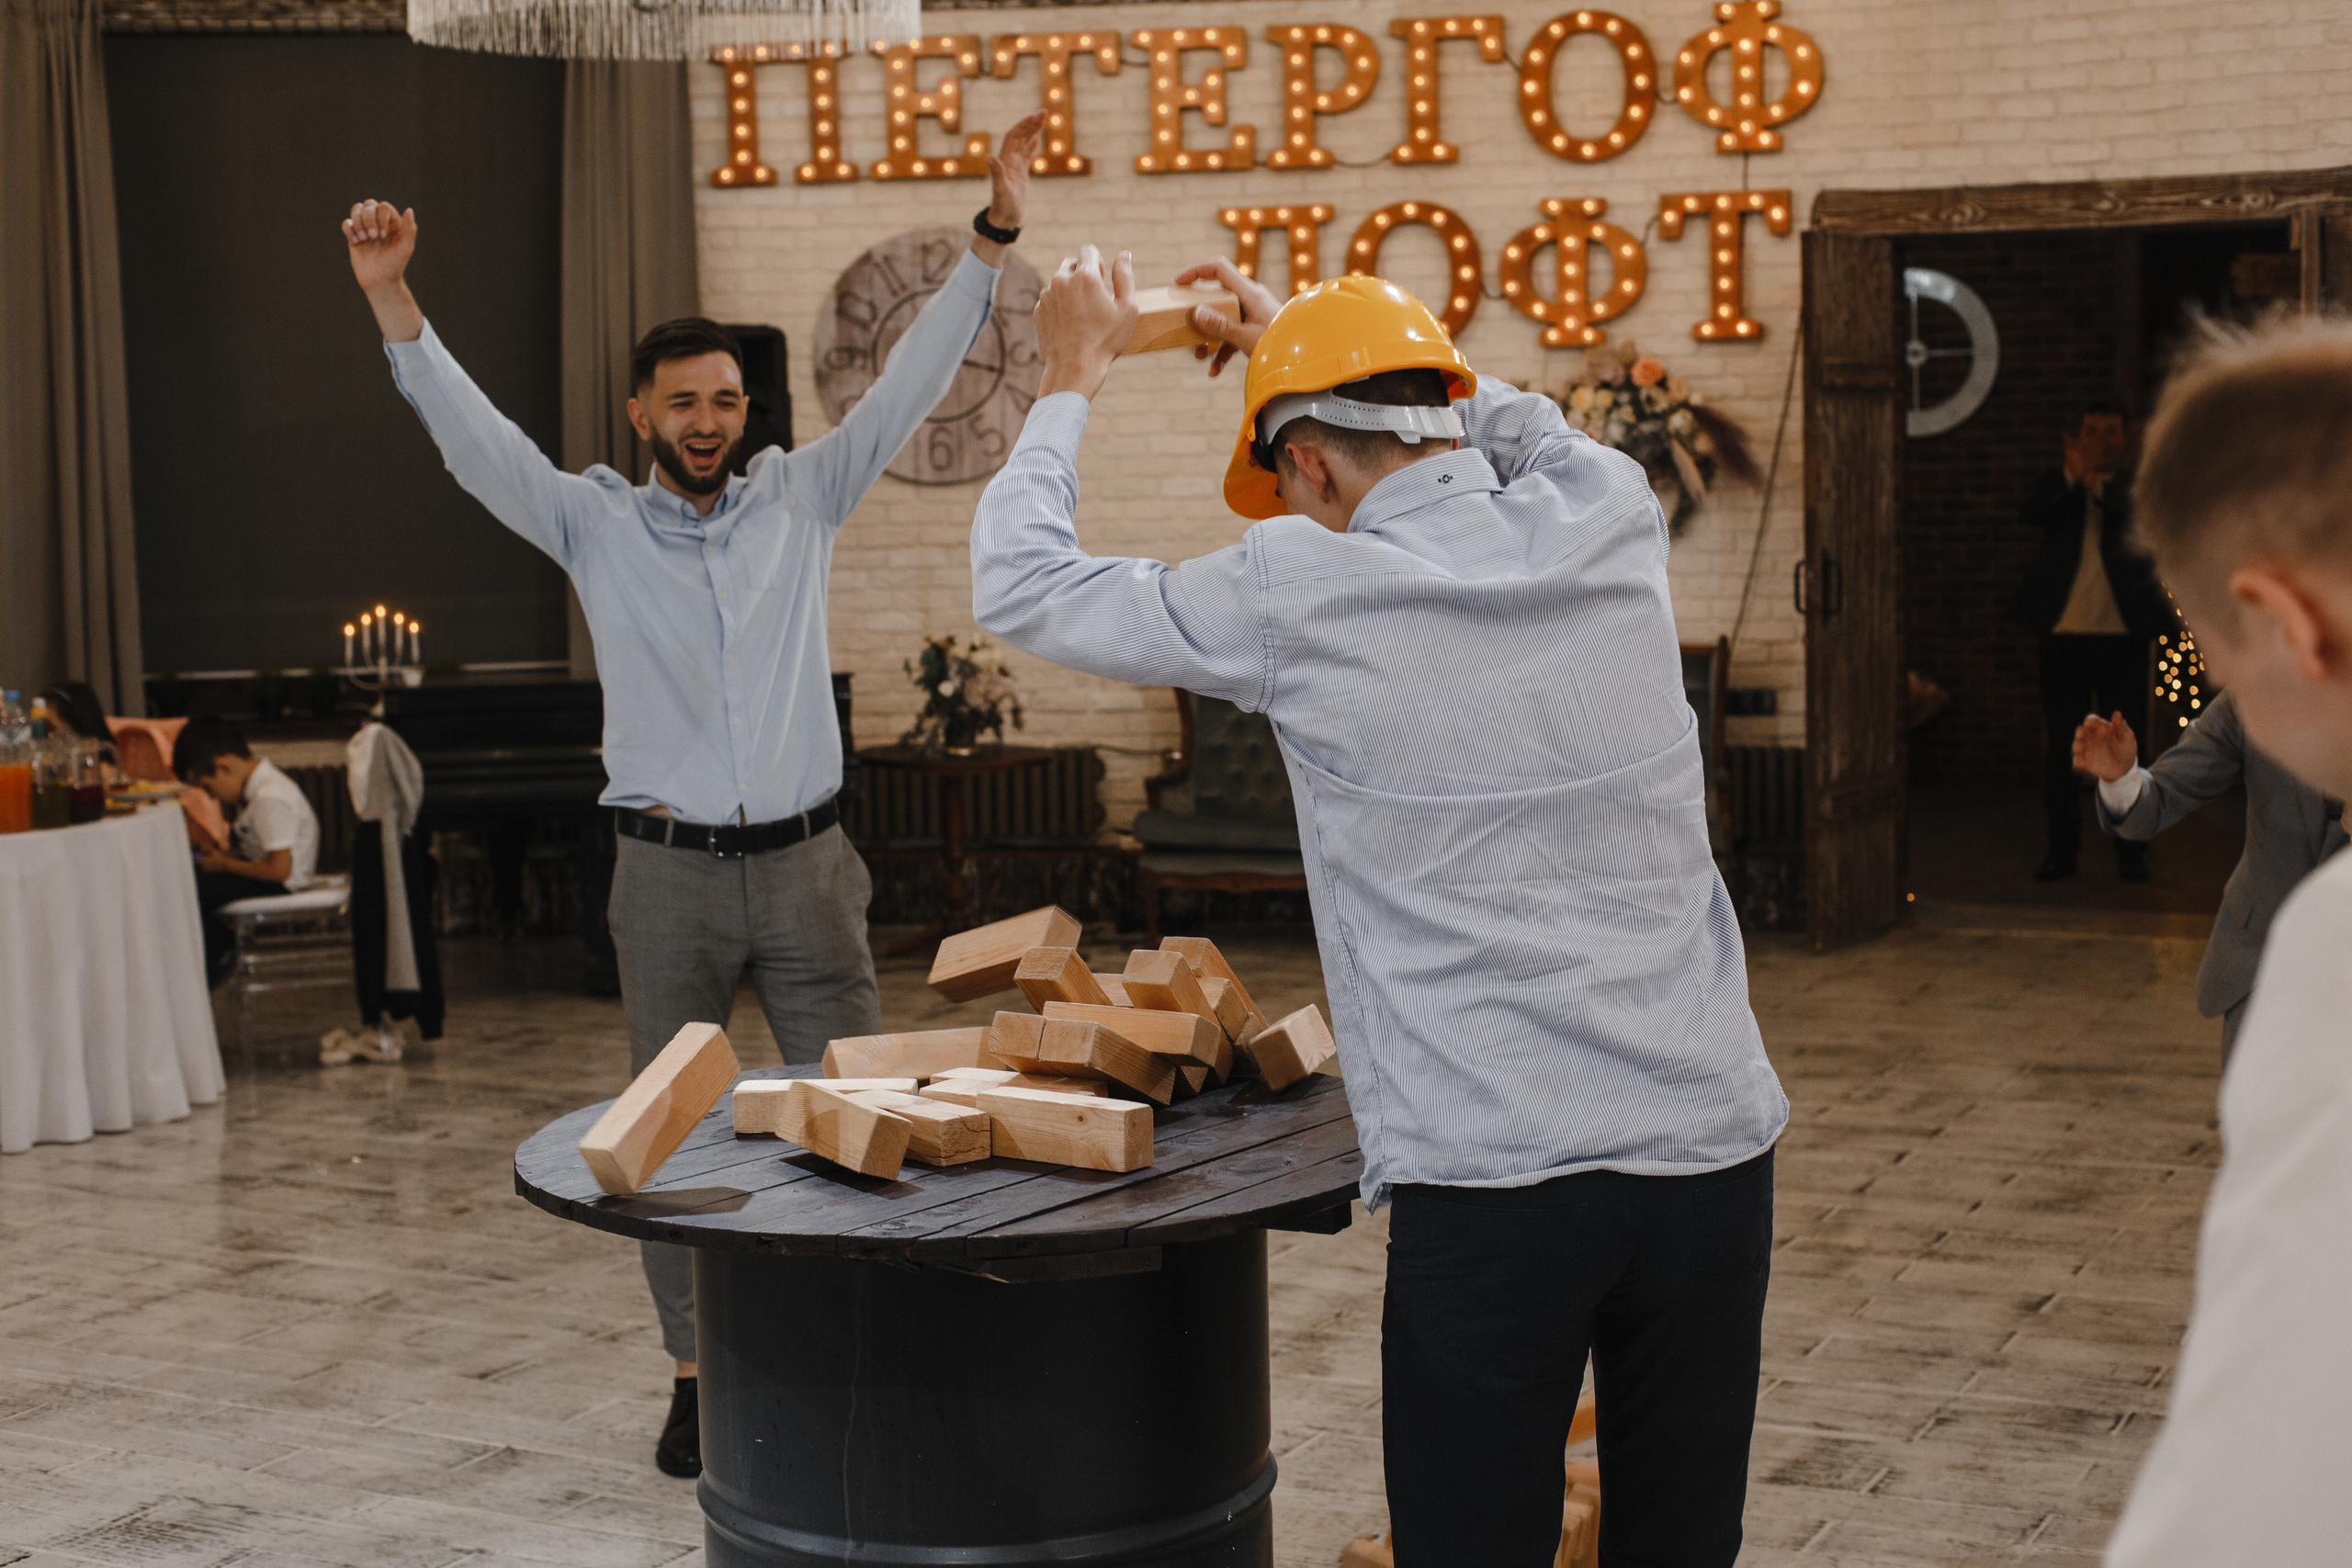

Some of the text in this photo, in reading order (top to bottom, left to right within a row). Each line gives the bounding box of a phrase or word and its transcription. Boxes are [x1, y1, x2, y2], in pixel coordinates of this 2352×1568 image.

[712, 0, 1824, 186] ПЕТЕРГОФ
[928, 425, 955, 471] 6
[967, 413, 1007, 458] 5
